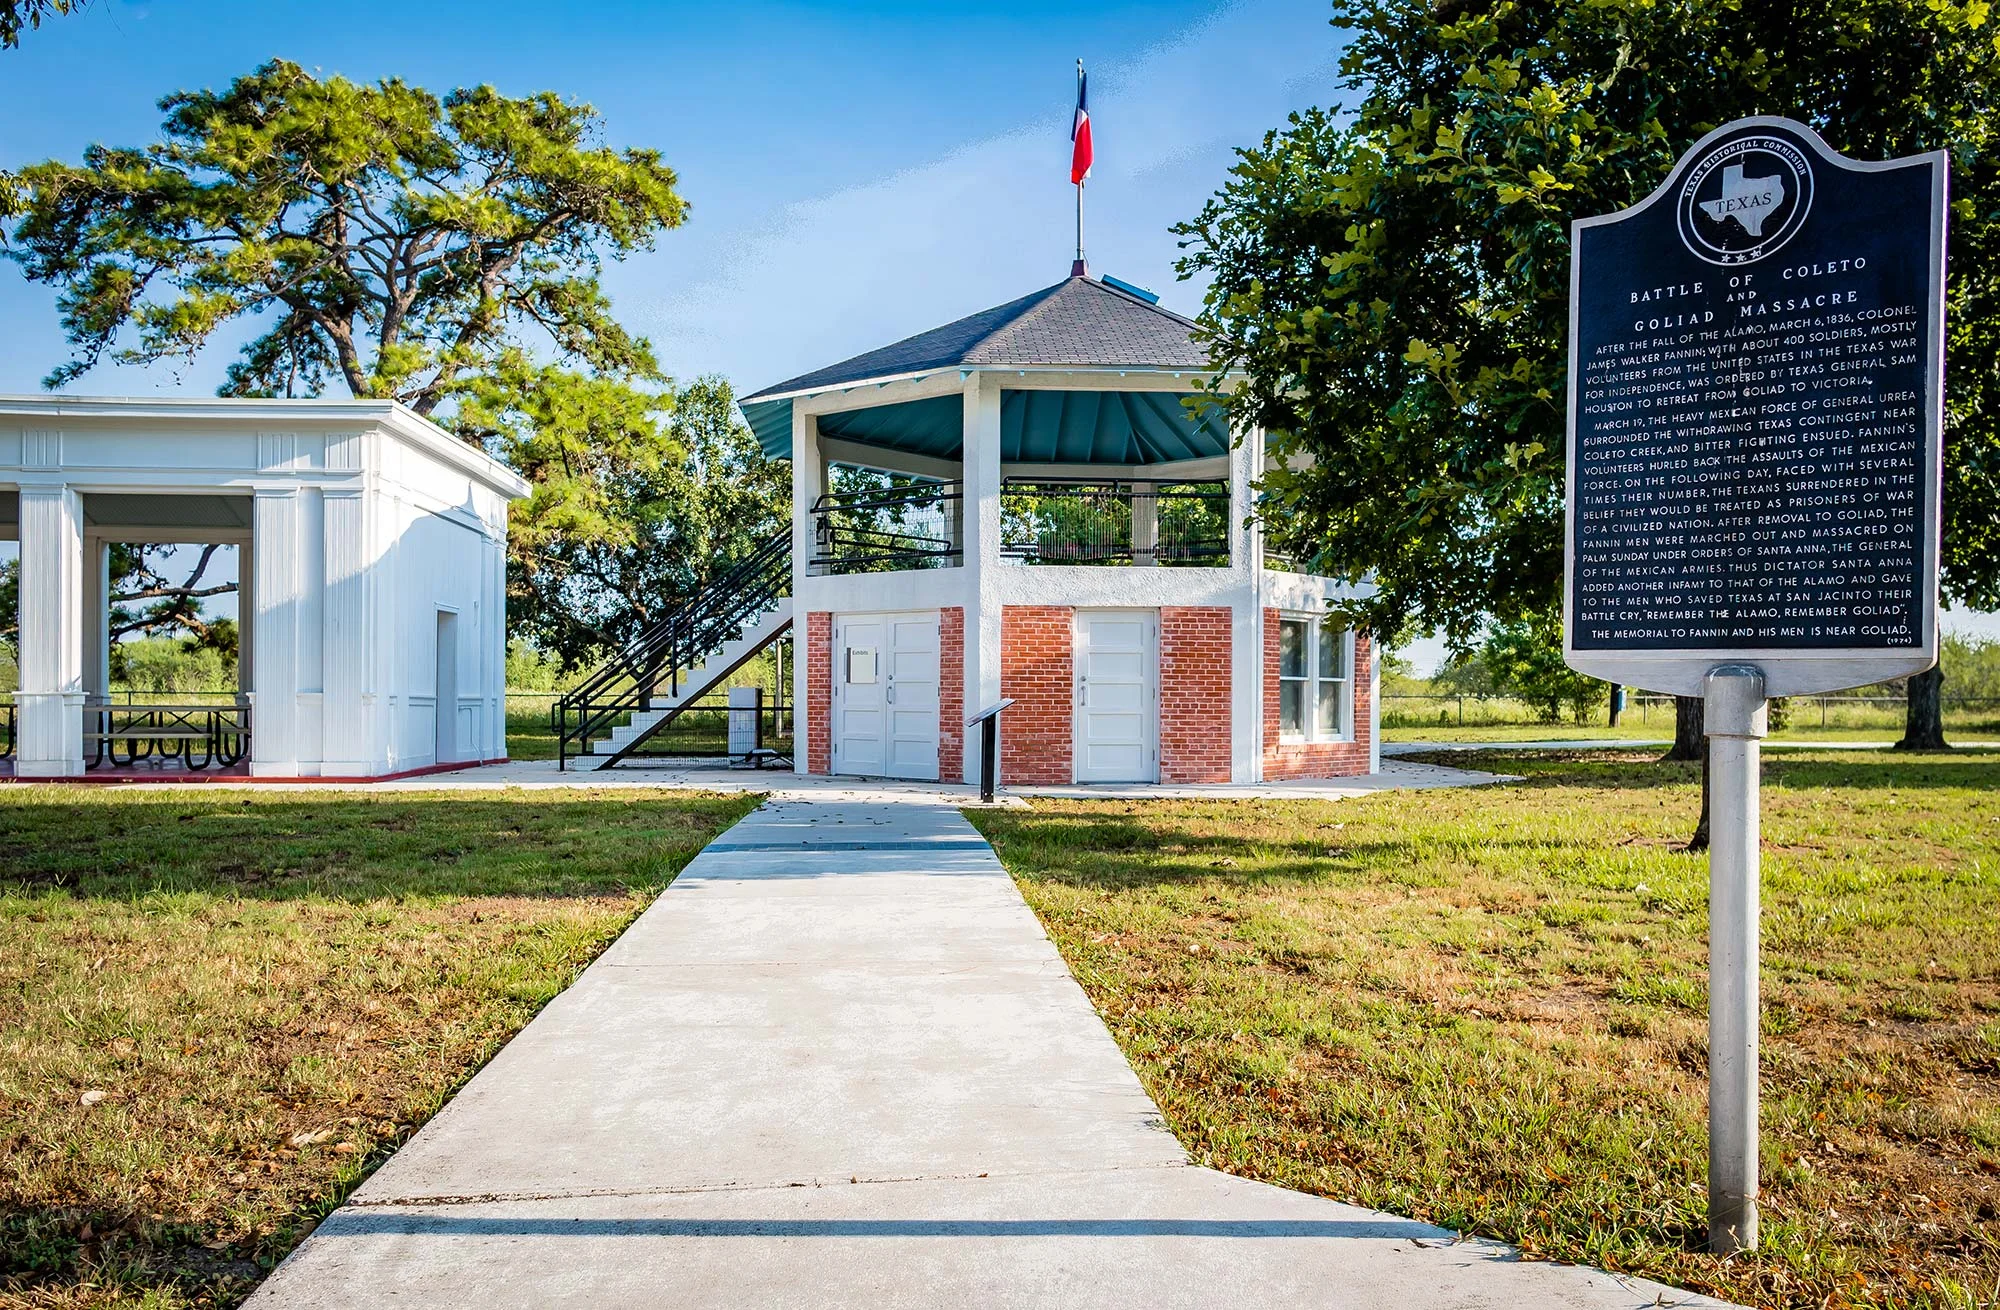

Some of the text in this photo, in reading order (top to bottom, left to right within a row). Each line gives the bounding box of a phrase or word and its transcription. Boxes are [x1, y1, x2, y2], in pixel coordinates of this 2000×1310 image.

[1685, 170, 1703, 197] TEXAS
[1763, 141, 1807, 175] COMMISSION
[1715, 192, 1772, 214] TEXAS
[1630, 257, 1866, 303] BATTLE OF COLETO
[1726, 290, 1757, 302] AND
[1634, 291, 1858, 332] GOLIAD MASSACRE
[1595, 343, 1624, 355] AFTER
[1629, 340, 1647, 351] THE
[1652, 336, 1674, 348] FALL
[1679, 334, 1693, 344] OF
[1700, 331, 1718, 342] THE
[1768, 319, 1810, 333] MARCH
[1856, 305, 1918, 322] COLONEL
[1594, 419, 1629, 431] MARCH
[1633, 417, 1645, 427] 19,
[1648, 415, 1666, 425] THE
[1672, 412, 1704, 423] HEAVY
[1761, 403, 1796, 415] FORCE
[1801, 401, 1816, 411] OF
[1822, 395, 1873, 409] GENERAL
[1879, 391, 1916, 403] URREA
[1583, 407, 1915, 447] SURROUNDED THE WITHDRAWING TEXAS CONTINGENT NEAR
[1584, 449, 1626, 460] COLETO
[1694, 439, 1732, 451] BITTER
[1738, 434, 1797, 447] FIGHTING
[1802, 429, 1855, 442] ENSUED.
[1858, 423, 1915, 437] FANNIN'S
[1584, 441, 1915, 476] VOLUNTEERS HURLED BACK THE ASSAULTS OF THE MEXICAN
[1583, 458, 1914, 491] FORCE. ON THE FOLLOWING DAY, FACED WITH SEVERAL
[1584, 474, 1914, 504] TIMES THEIR NUMBER, THE TEXANS SURRENDERED IN THE
[1583, 491, 1914, 520] BELIEF THEY WOULD BE TREATED AS PRISONERS OF WAR
[1583, 507, 1913, 535] OF A CIVILIZED NATION. AFTER REMOVAL TO GOLIAD, THE
[1582, 524, 1913, 549] FANNIN MEN WERE MARCHED OUT AND MASSACRED ON
[1582, 540, 1912, 563] PALM SUNDAY UNDER ORDERS OF SANTA ANNA, THE GENERAL
[1582, 558, 1912, 578] OF THE MEXICAN ARMIES. THUS DICTATOR SANTA ANNA
[1582, 574, 1911, 592] ADDED ANOTHER INFAMY TO THAT OF THE ALAMO AND GAVE
[1582, 590, 1912, 606] TO THE MEN WHO SAVED TEXAS AT SAN JACINTO THEIR
[1581, 611, 1615, 621] BATTLE
[1619, 611, 1642, 621] CRY,
[1709, 609, 1729, 618] THE
[1735, 608, 1781, 619] ALAMO,
[1784, 607, 1846, 617] REMEMBER
[1591, 625, 1911, 639] THE MEMORIAL TO FANNIN AND HIS MEN IS NEAR GOLIAD.
